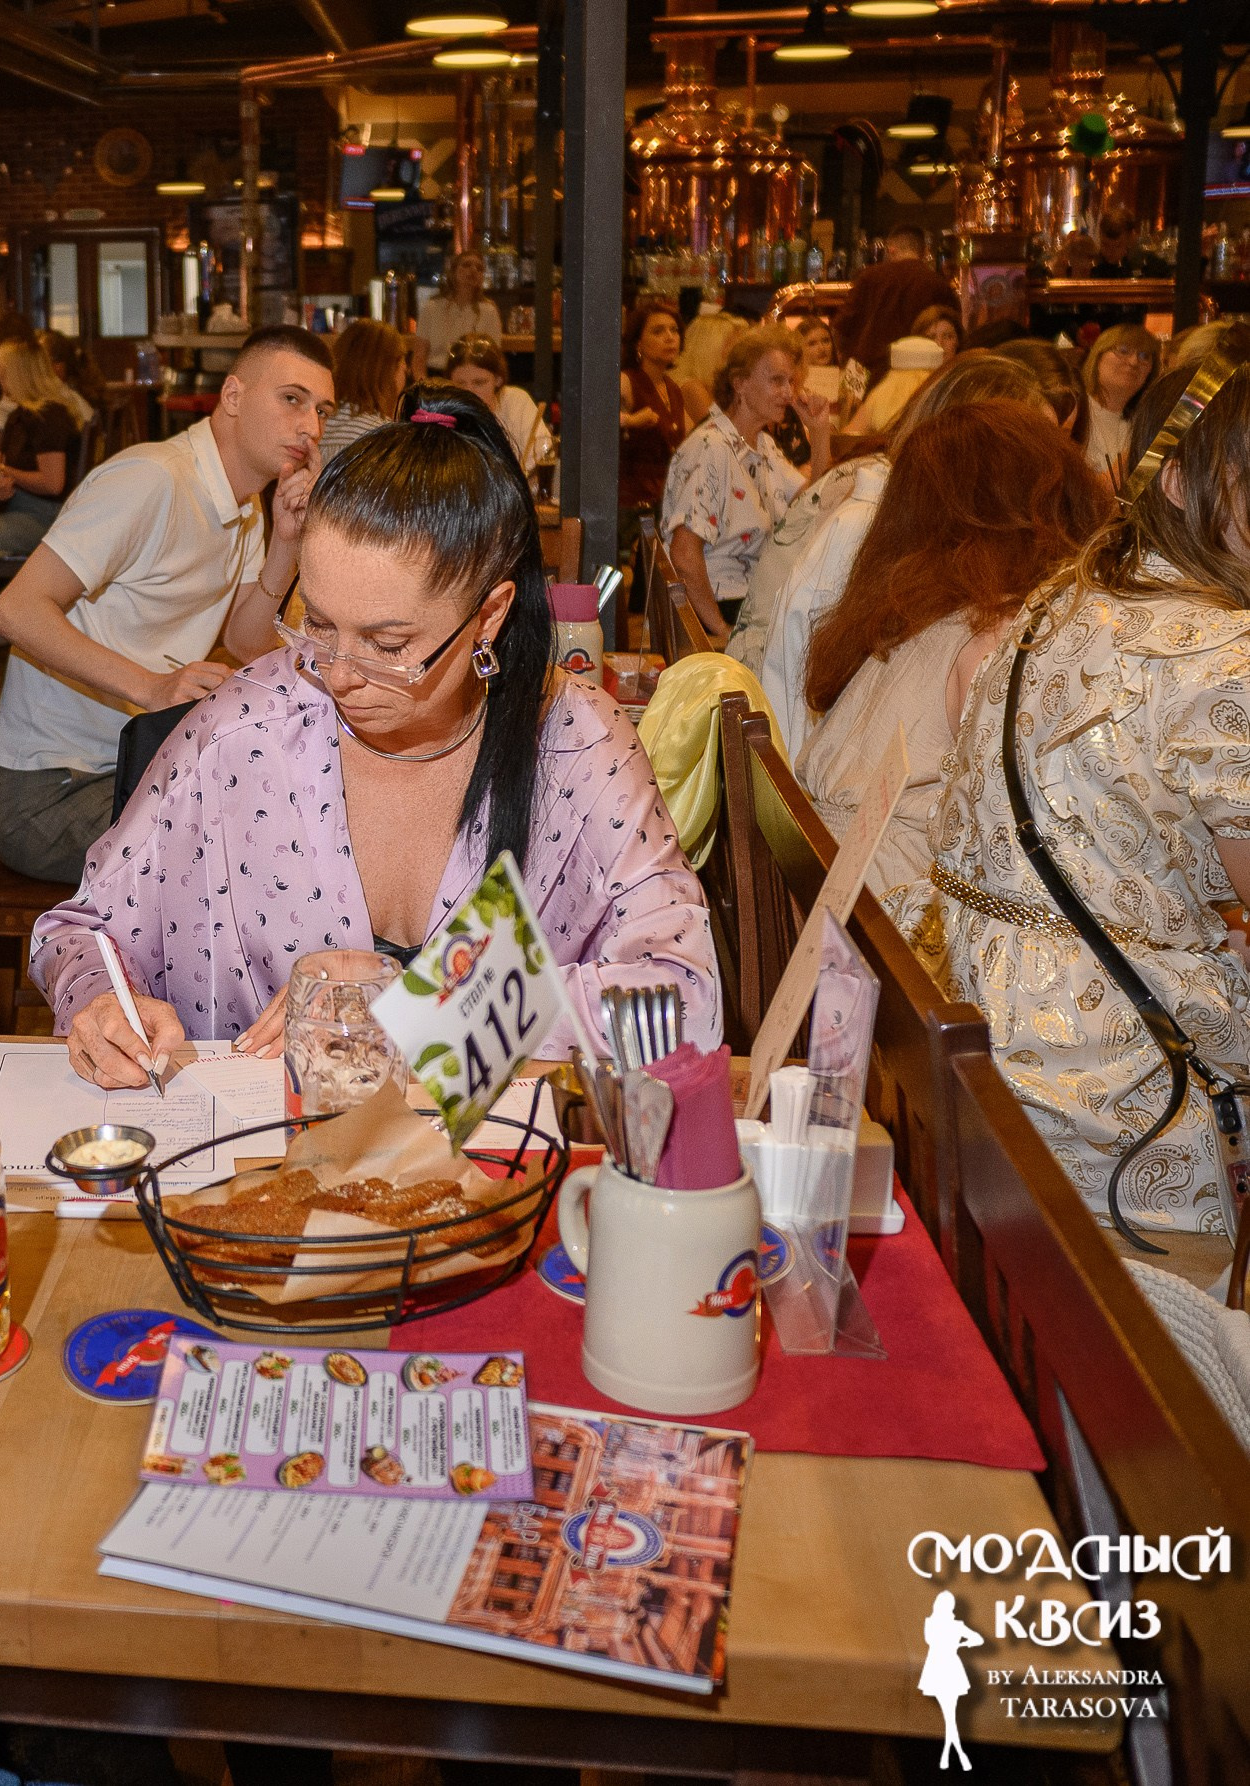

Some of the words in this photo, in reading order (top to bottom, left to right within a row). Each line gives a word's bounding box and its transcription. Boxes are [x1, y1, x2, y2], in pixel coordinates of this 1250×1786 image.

[459, 978, 485, 1018] СТОЛ
[463, 968, 538, 1098] 412
[709, 1294, 733, 1307] Max
